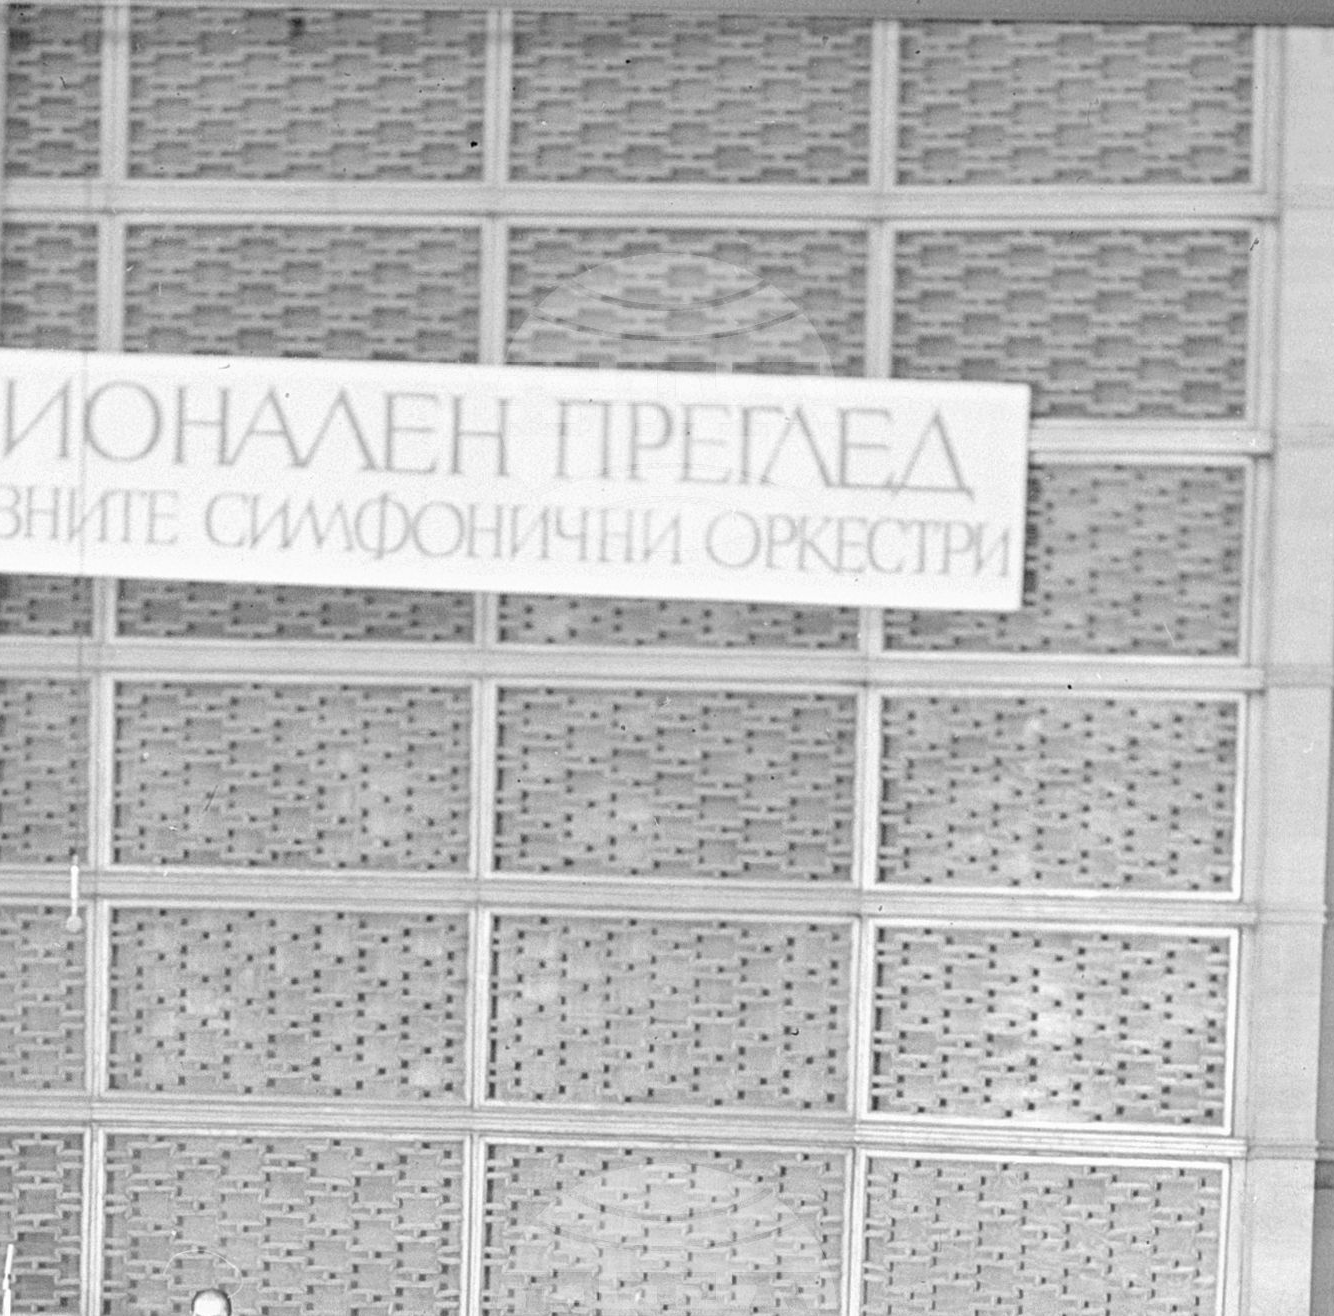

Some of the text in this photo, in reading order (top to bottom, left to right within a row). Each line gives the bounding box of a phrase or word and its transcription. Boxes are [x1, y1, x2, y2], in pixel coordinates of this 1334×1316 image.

[555, 396, 975, 501] ПРЕГЛЕД
[202, 489, 683, 566] СИМФОНИЧНИ
[703, 508, 1012, 579] ОРКЕСТРИ
